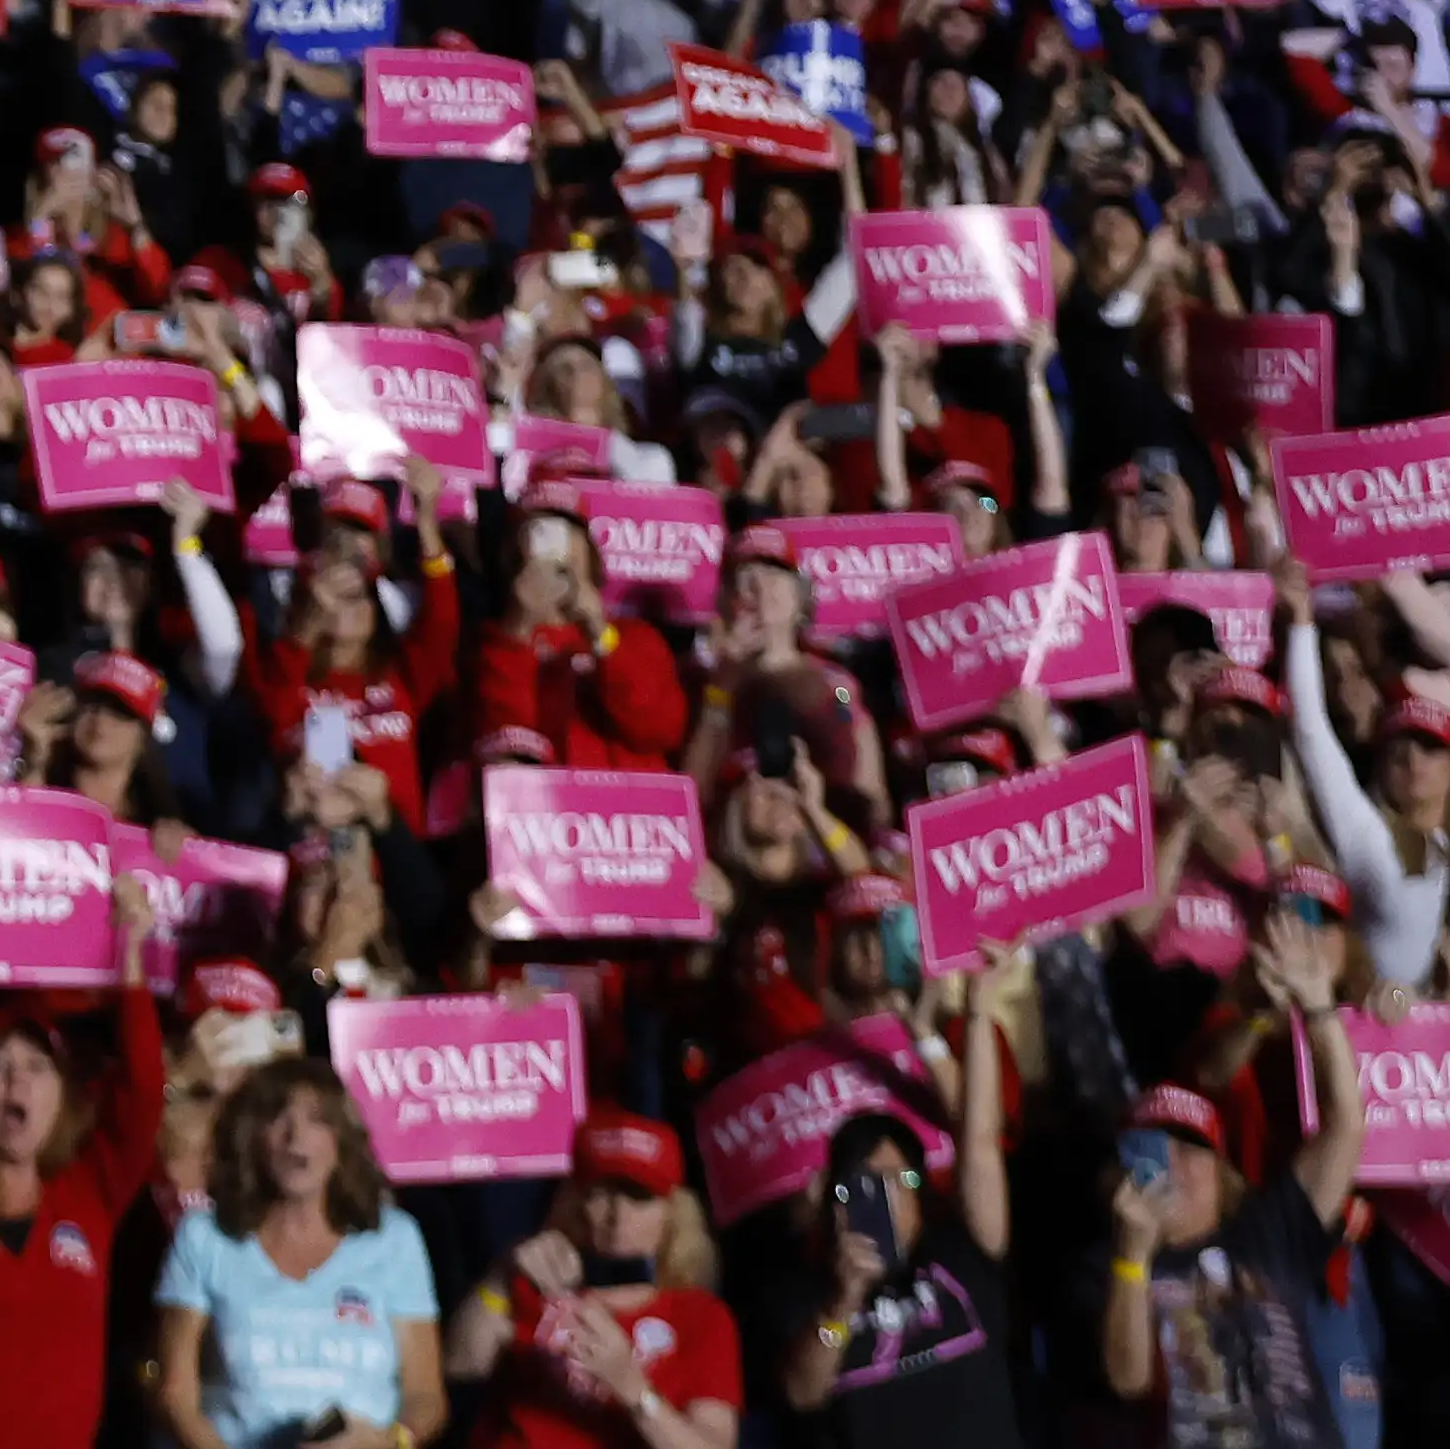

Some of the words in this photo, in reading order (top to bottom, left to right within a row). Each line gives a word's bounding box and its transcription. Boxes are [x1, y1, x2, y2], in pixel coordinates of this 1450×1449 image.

[367, 364, 478, 417] OMEN
[45, 396, 217, 445] WOMEN
[588, 516, 724, 563] OMEN
[503, 813, 693, 861] WOMEN
[931, 785, 1137, 895] WOMEN
[1009, 842, 1108, 903] TRUMP
[356, 1039, 566, 1102] WOMEN
